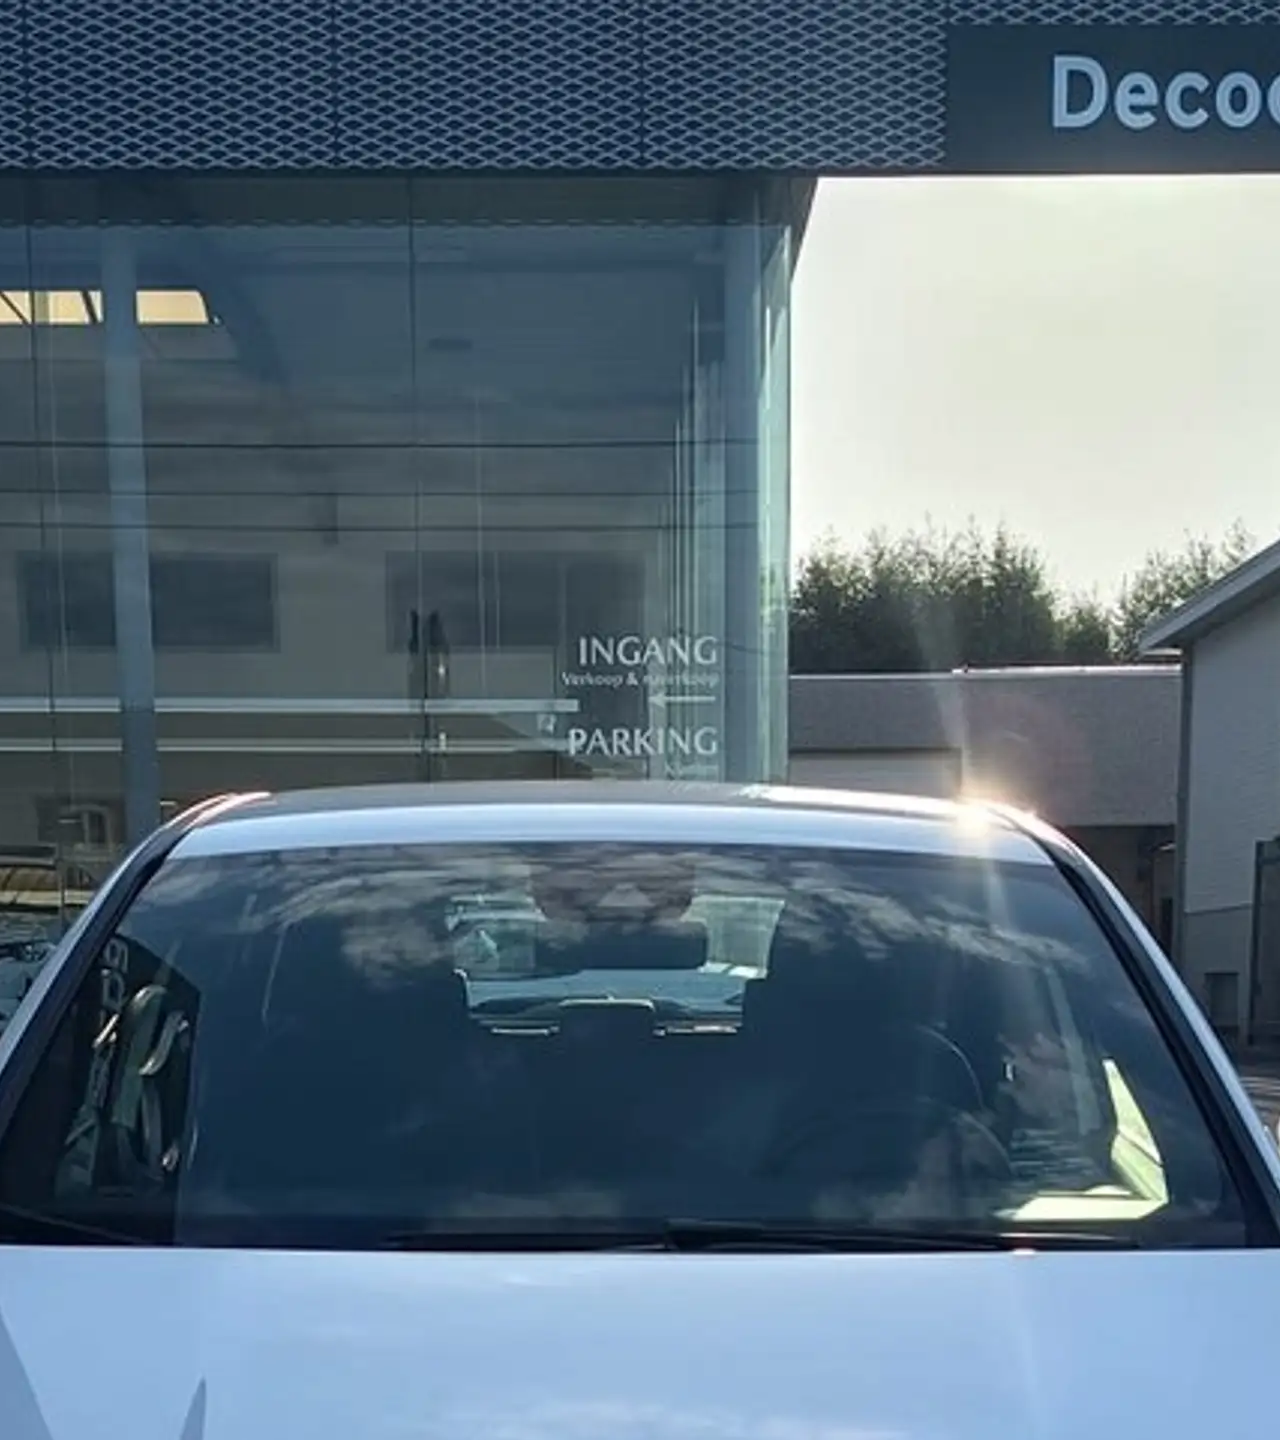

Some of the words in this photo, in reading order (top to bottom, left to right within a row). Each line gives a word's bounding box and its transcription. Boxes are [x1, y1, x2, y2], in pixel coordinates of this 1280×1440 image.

[579, 635, 718, 667] INGANG
[625, 672, 639, 686] &
[570, 727, 718, 756] PARKING
